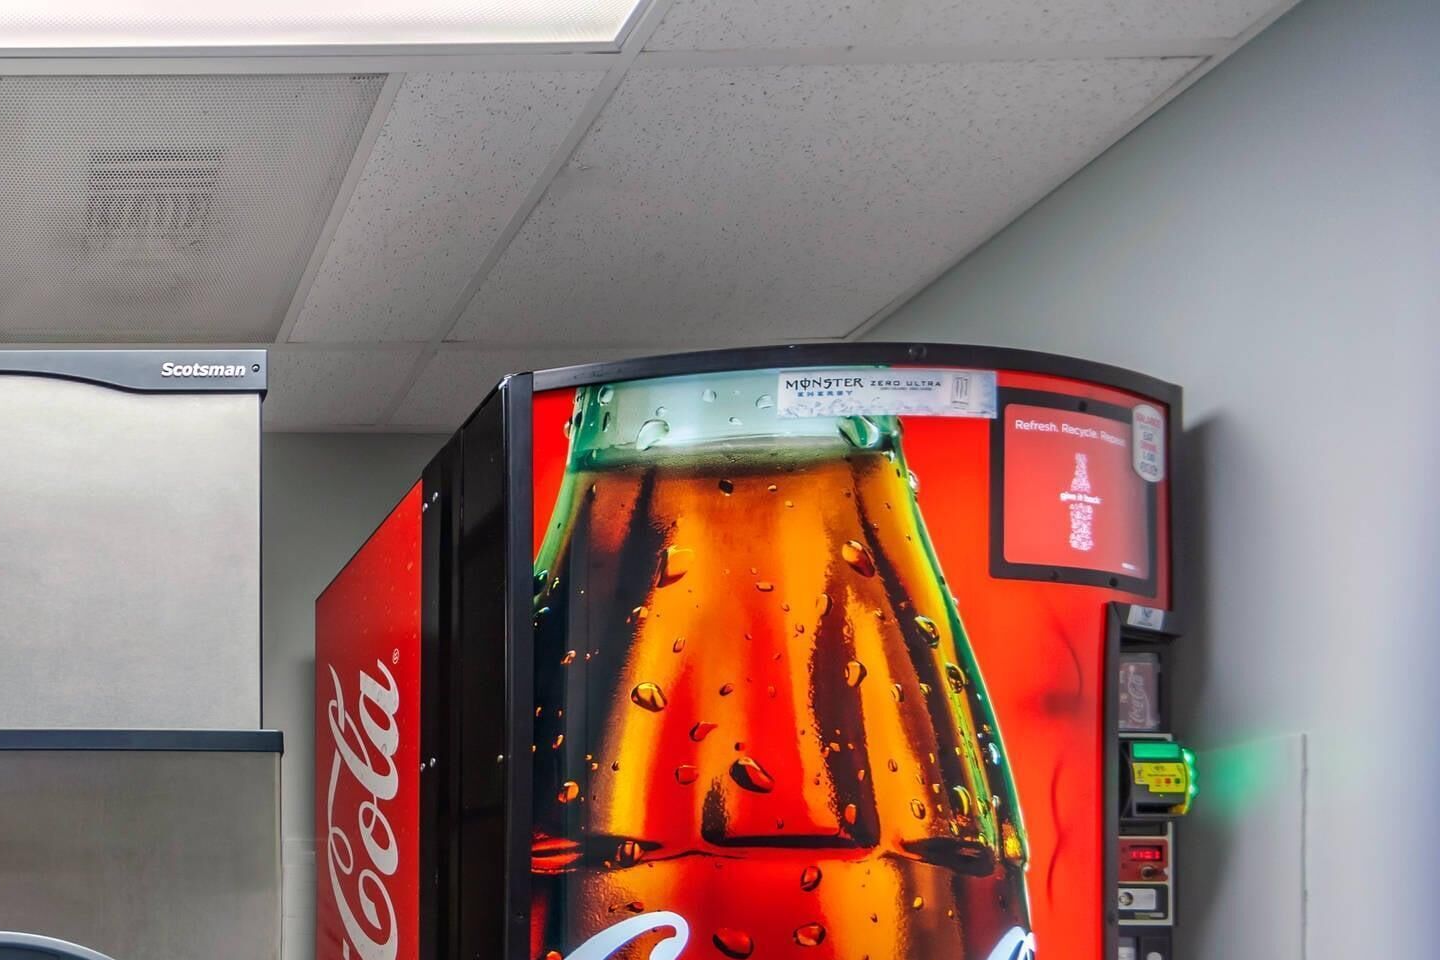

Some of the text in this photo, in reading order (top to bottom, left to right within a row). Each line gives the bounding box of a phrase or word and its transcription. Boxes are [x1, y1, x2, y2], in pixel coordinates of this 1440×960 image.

[161, 362, 247, 377] Scotsman
[786, 377, 864, 390] MONSTER
[1015, 419, 1059, 433] Refresh.
